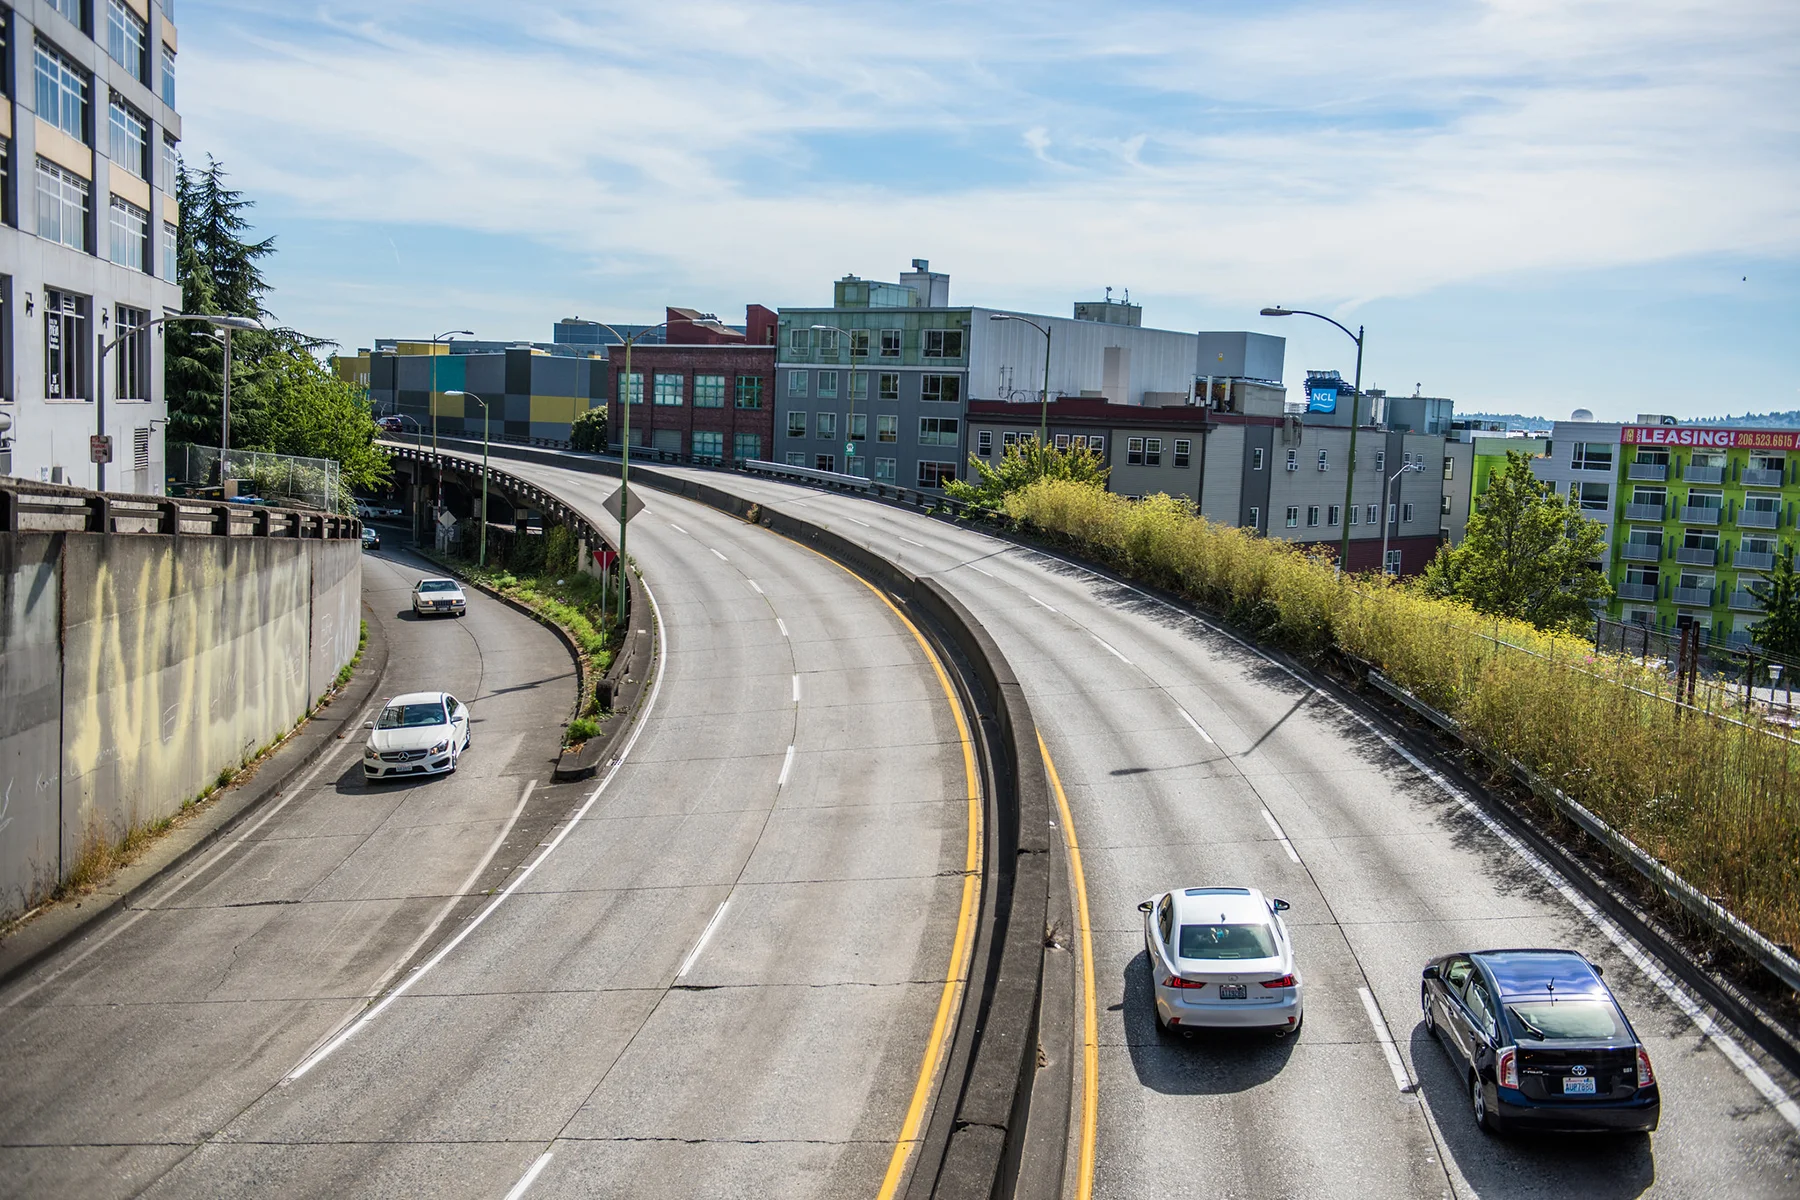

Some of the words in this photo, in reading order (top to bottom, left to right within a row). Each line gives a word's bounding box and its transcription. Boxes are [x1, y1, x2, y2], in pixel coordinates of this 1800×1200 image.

[1313, 393, 1333, 401] NCL
[1641, 429, 1735, 446] LEASING!
[1738, 433, 1793, 447] 206.523.6615
